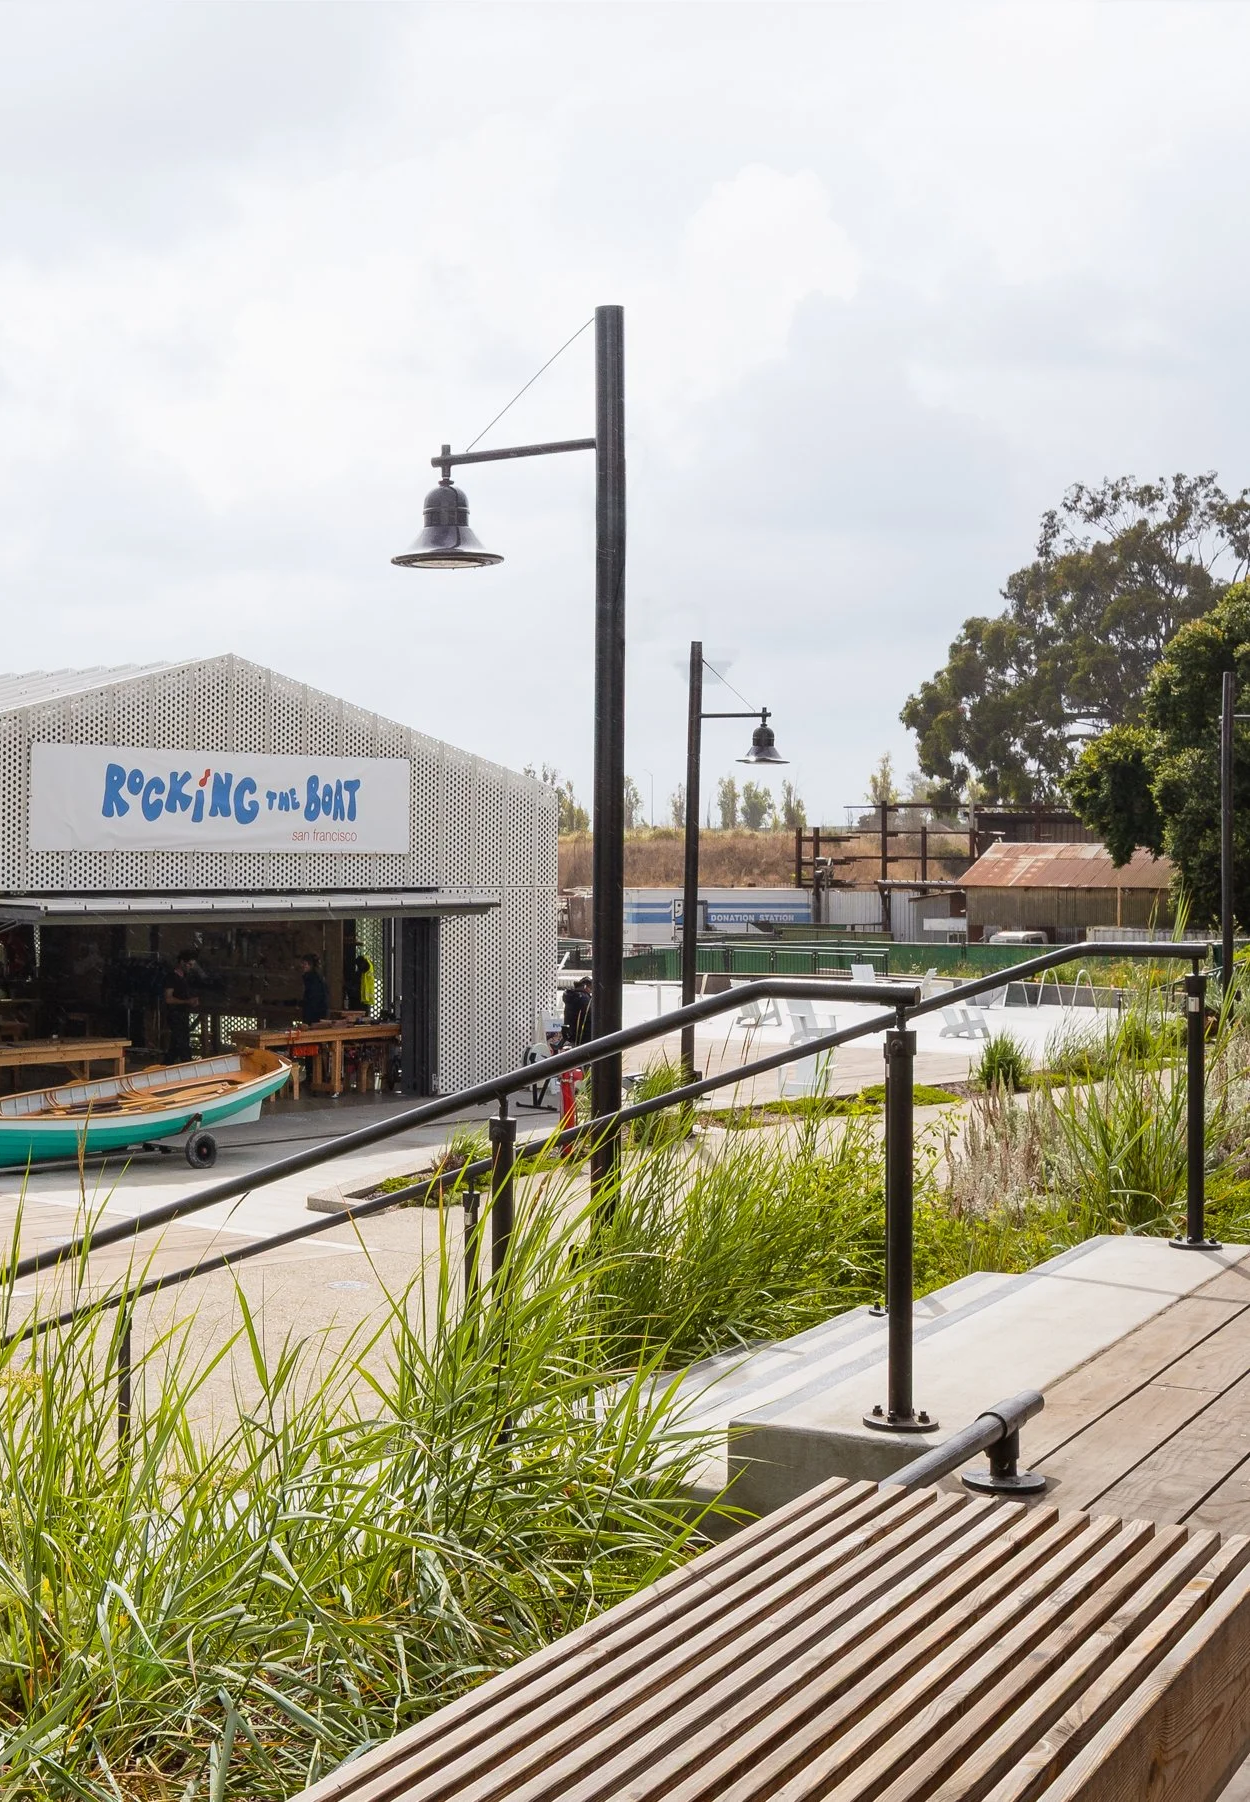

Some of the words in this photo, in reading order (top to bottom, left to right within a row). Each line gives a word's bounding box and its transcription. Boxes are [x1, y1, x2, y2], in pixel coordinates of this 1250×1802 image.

[266, 788, 300, 812] THE
[304, 775, 361, 822] BOAT
[292, 831, 310, 841] san
[312, 829, 357, 842] francisco
